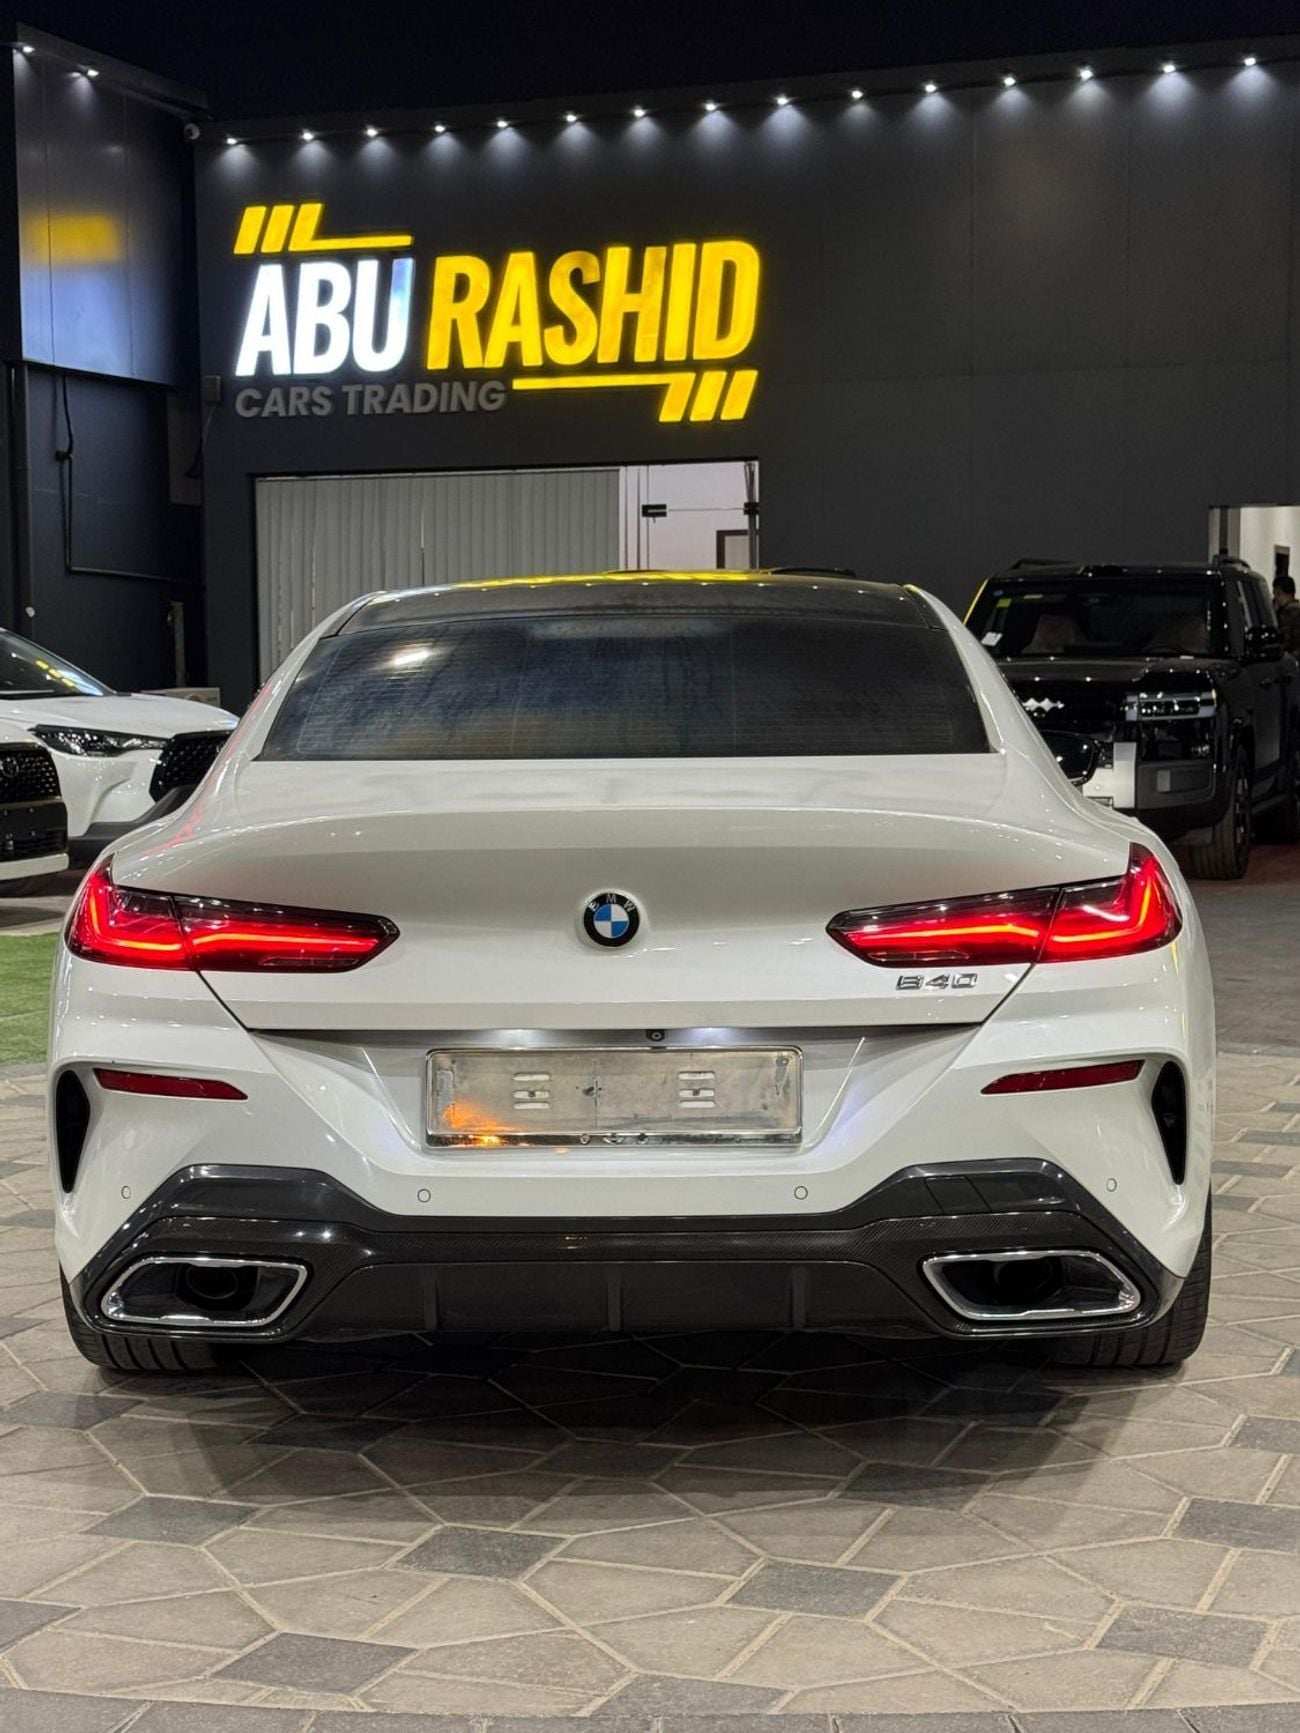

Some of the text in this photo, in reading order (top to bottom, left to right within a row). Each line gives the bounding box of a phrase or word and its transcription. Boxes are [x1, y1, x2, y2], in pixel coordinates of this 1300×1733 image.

[235, 240, 760, 376] ABU RASHID
[235, 380, 507, 418] CARS TRADING
[588, 893, 636, 912] BMW
[895, 973, 977, 990] 840
